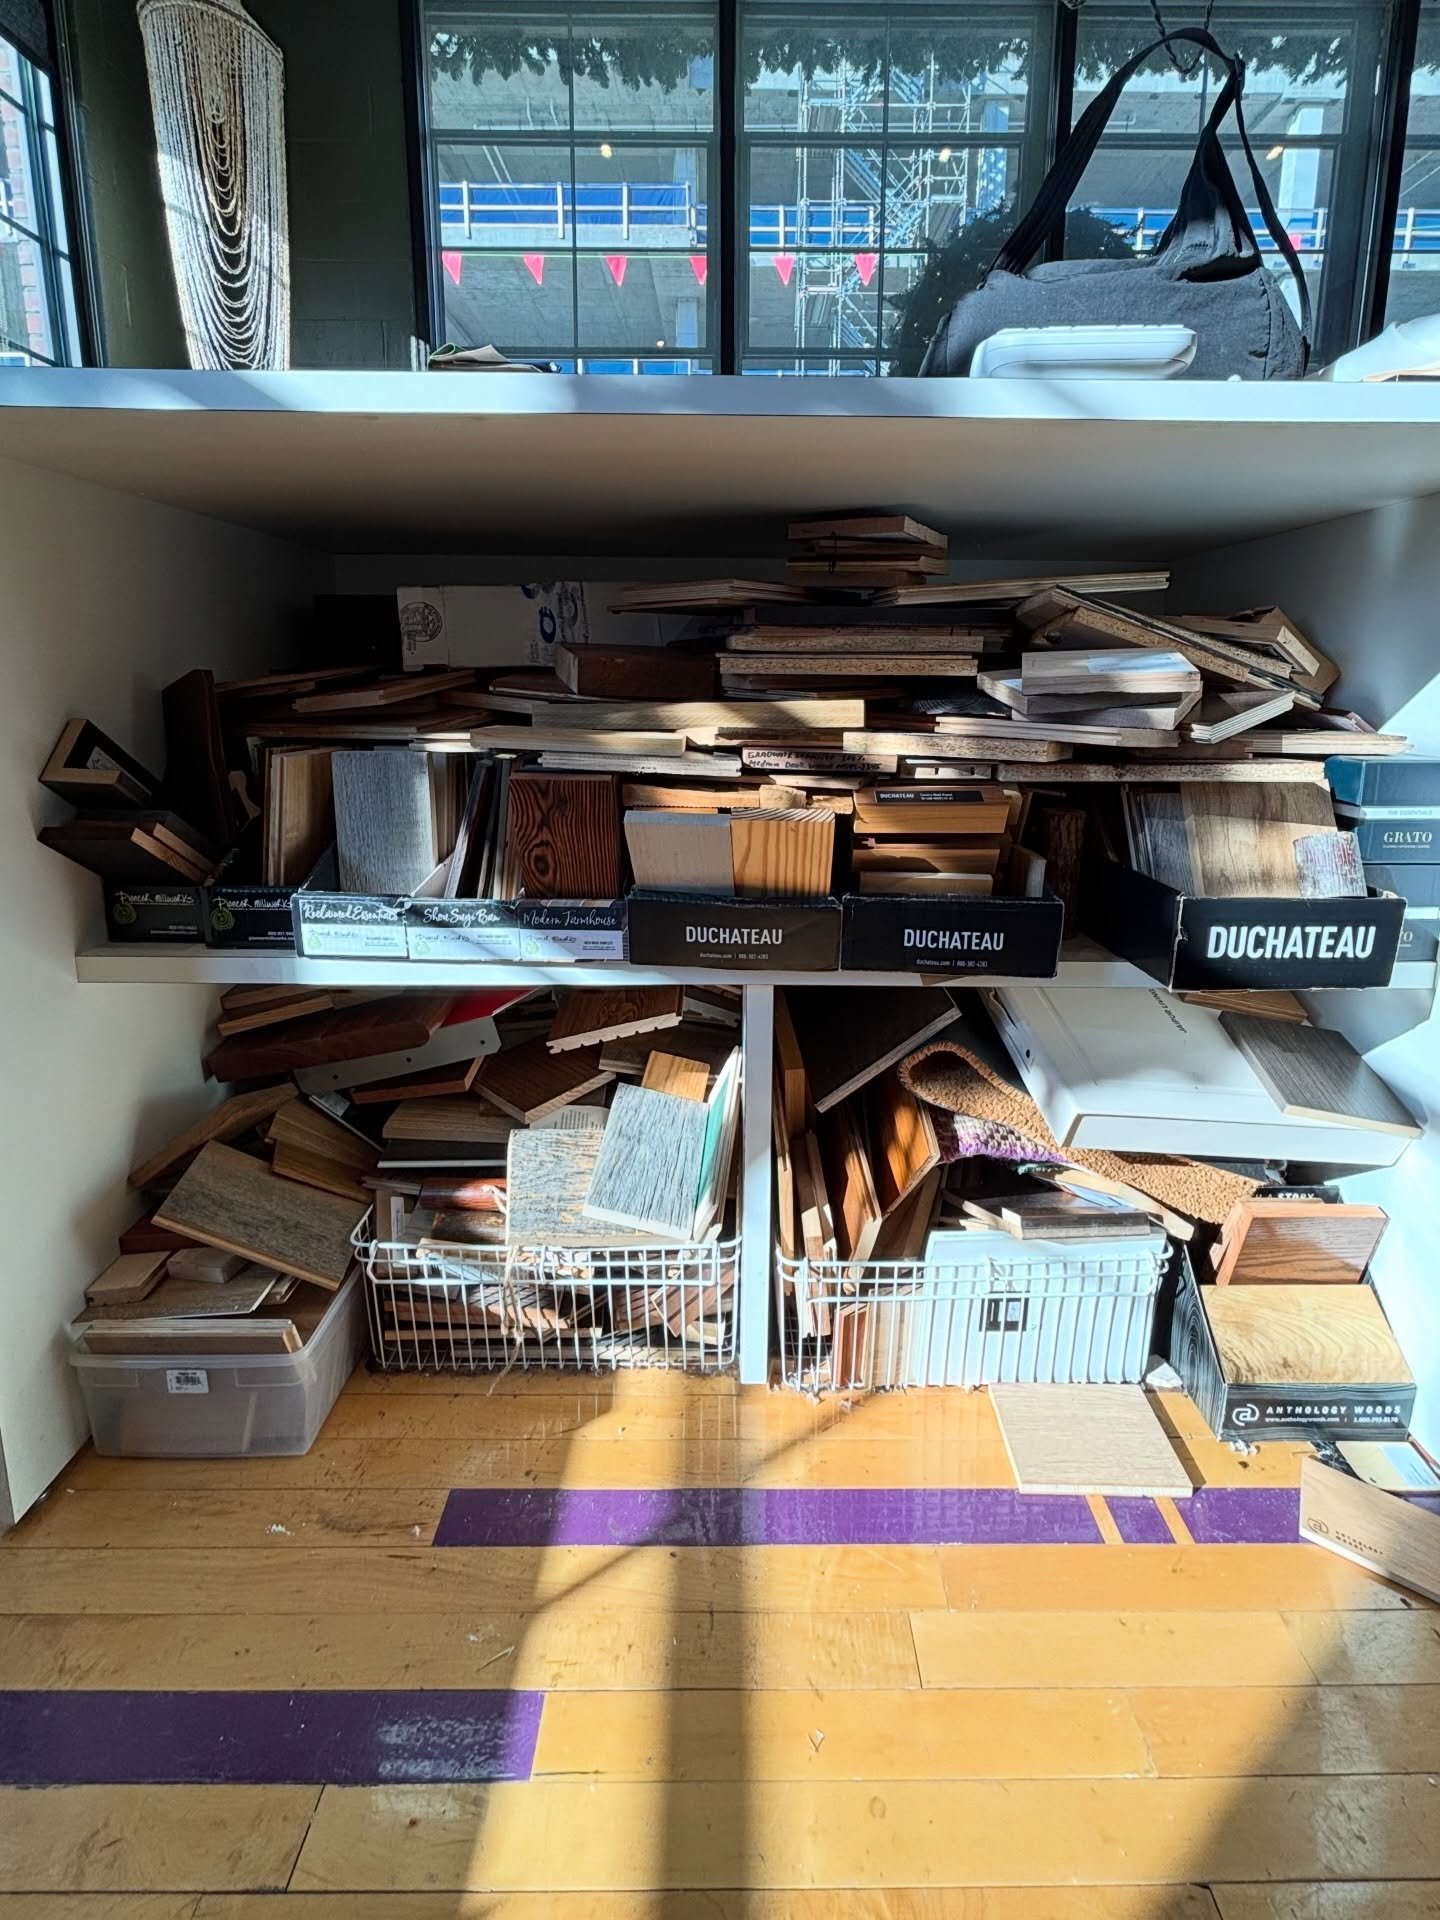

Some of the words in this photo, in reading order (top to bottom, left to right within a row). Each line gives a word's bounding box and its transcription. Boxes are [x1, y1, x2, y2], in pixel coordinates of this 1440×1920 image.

[1384, 831, 1433, 843] GRATO
[304, 904, 352, 919] Reclaimed
[423, 907, 450, 923] Shou
[450, 908, 476, 928] Sugi
[476, 908, 500, 924] Ban
[523, 909, 561, 926] Modern
[562, 909, 617, 926] Farmhouse
[685, 926, 782, 944] DUCHATEAU
[904, 928, 1005, 951] DUCHATEAU
[1207, 925, 1377, 959] DUCHATEAU
[1266, 1406, 1347, 1415] ANTHOLOGY
[1354, 1406, 1401, 1415] WOODS
